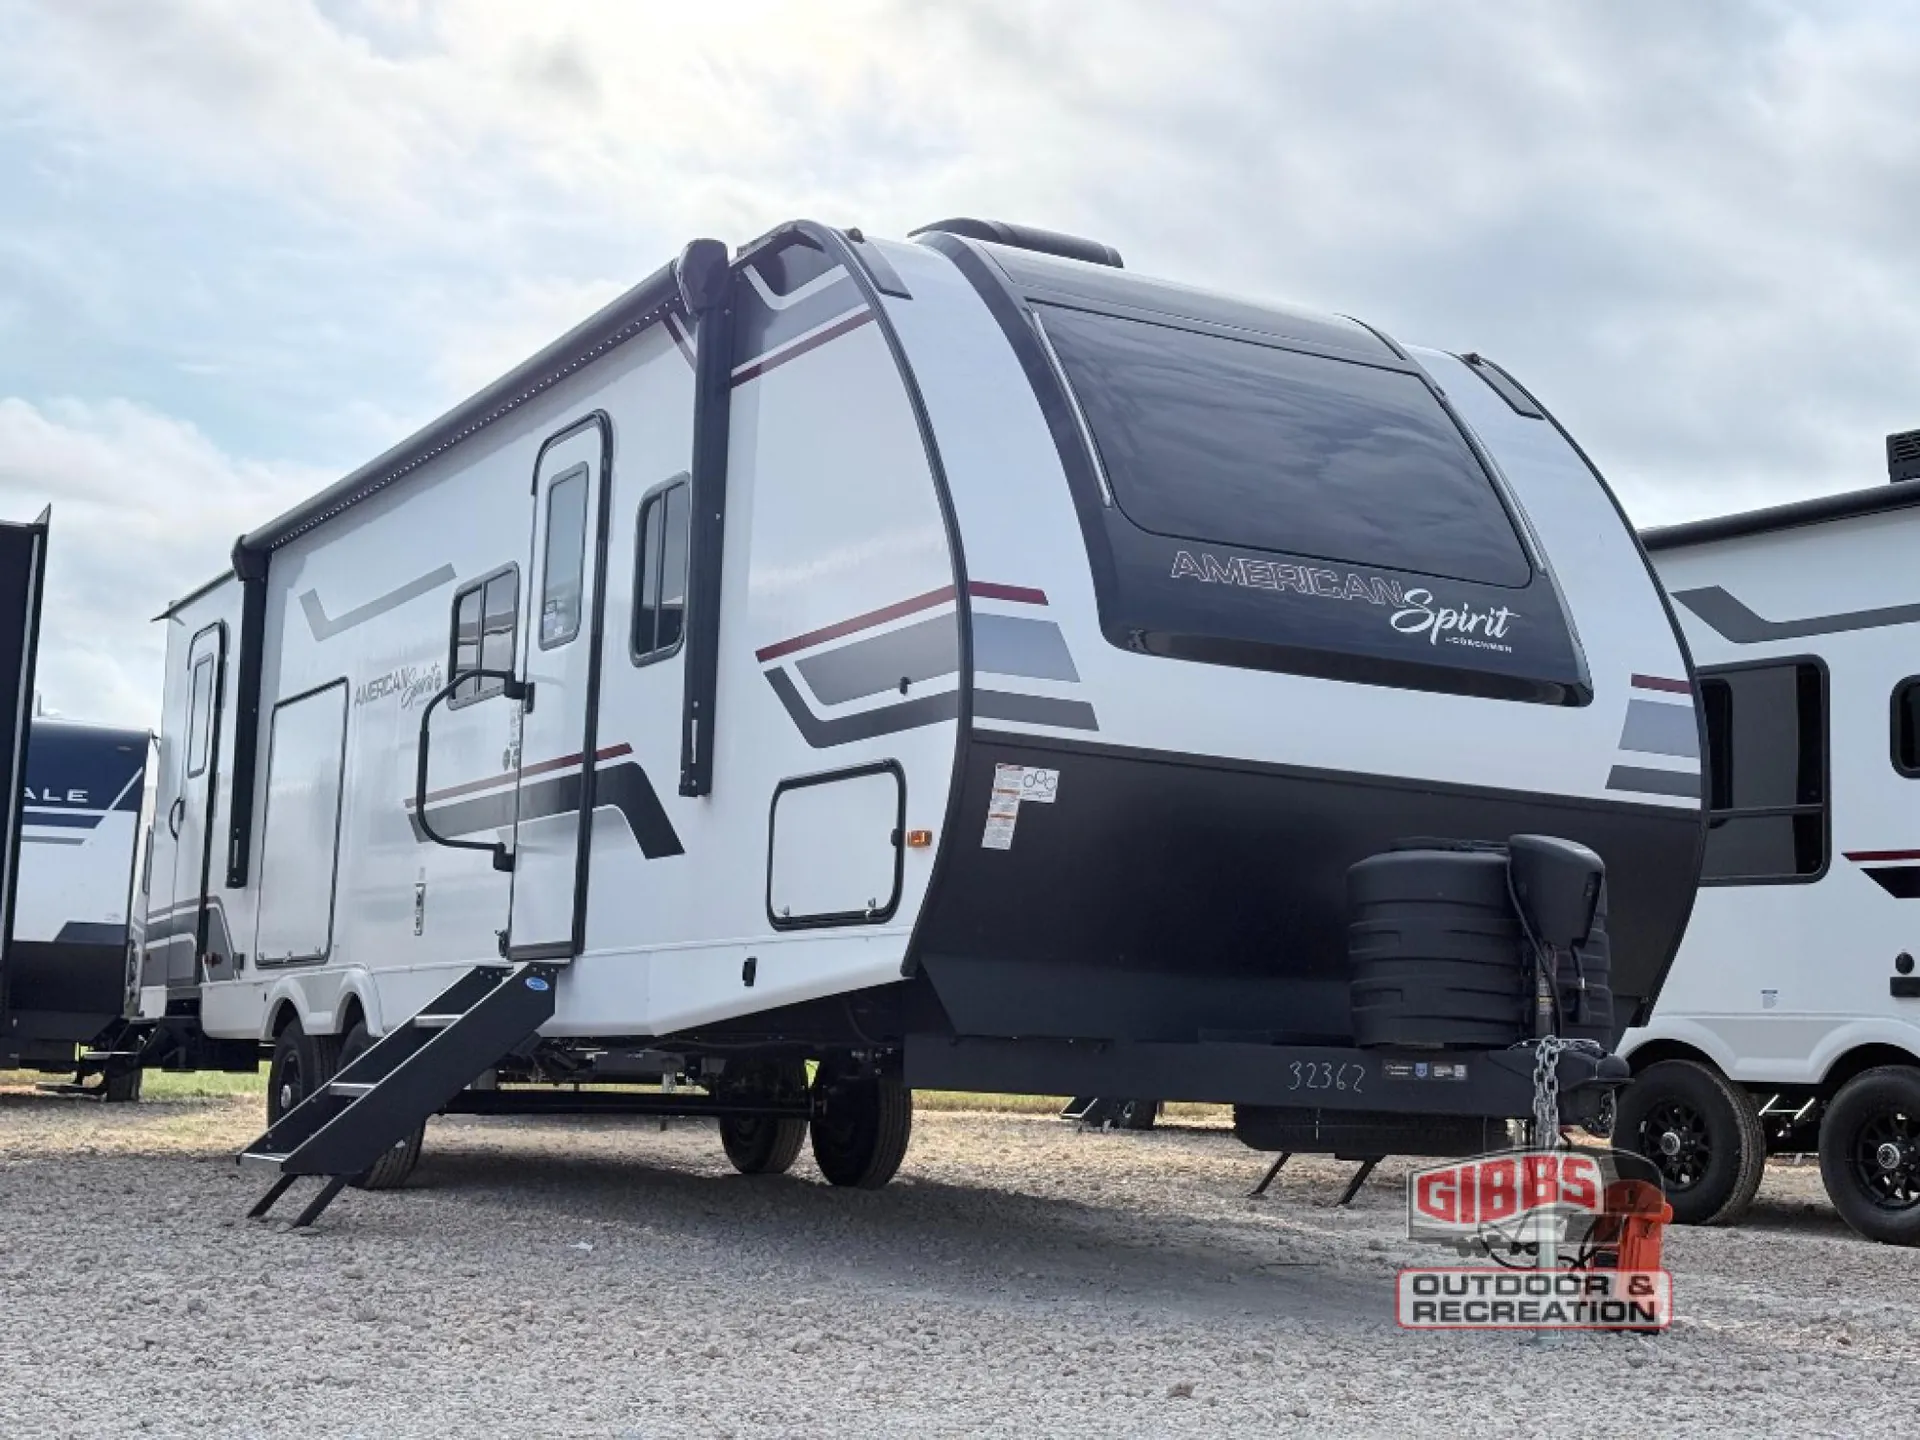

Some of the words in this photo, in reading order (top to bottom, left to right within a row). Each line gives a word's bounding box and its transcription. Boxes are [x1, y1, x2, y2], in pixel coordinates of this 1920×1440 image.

[1170, 551, 1405, 608] AMERICAN
[1390, 588, 1521, 645] Spirit
[1287, 1060, 1366, 1093] 32362
